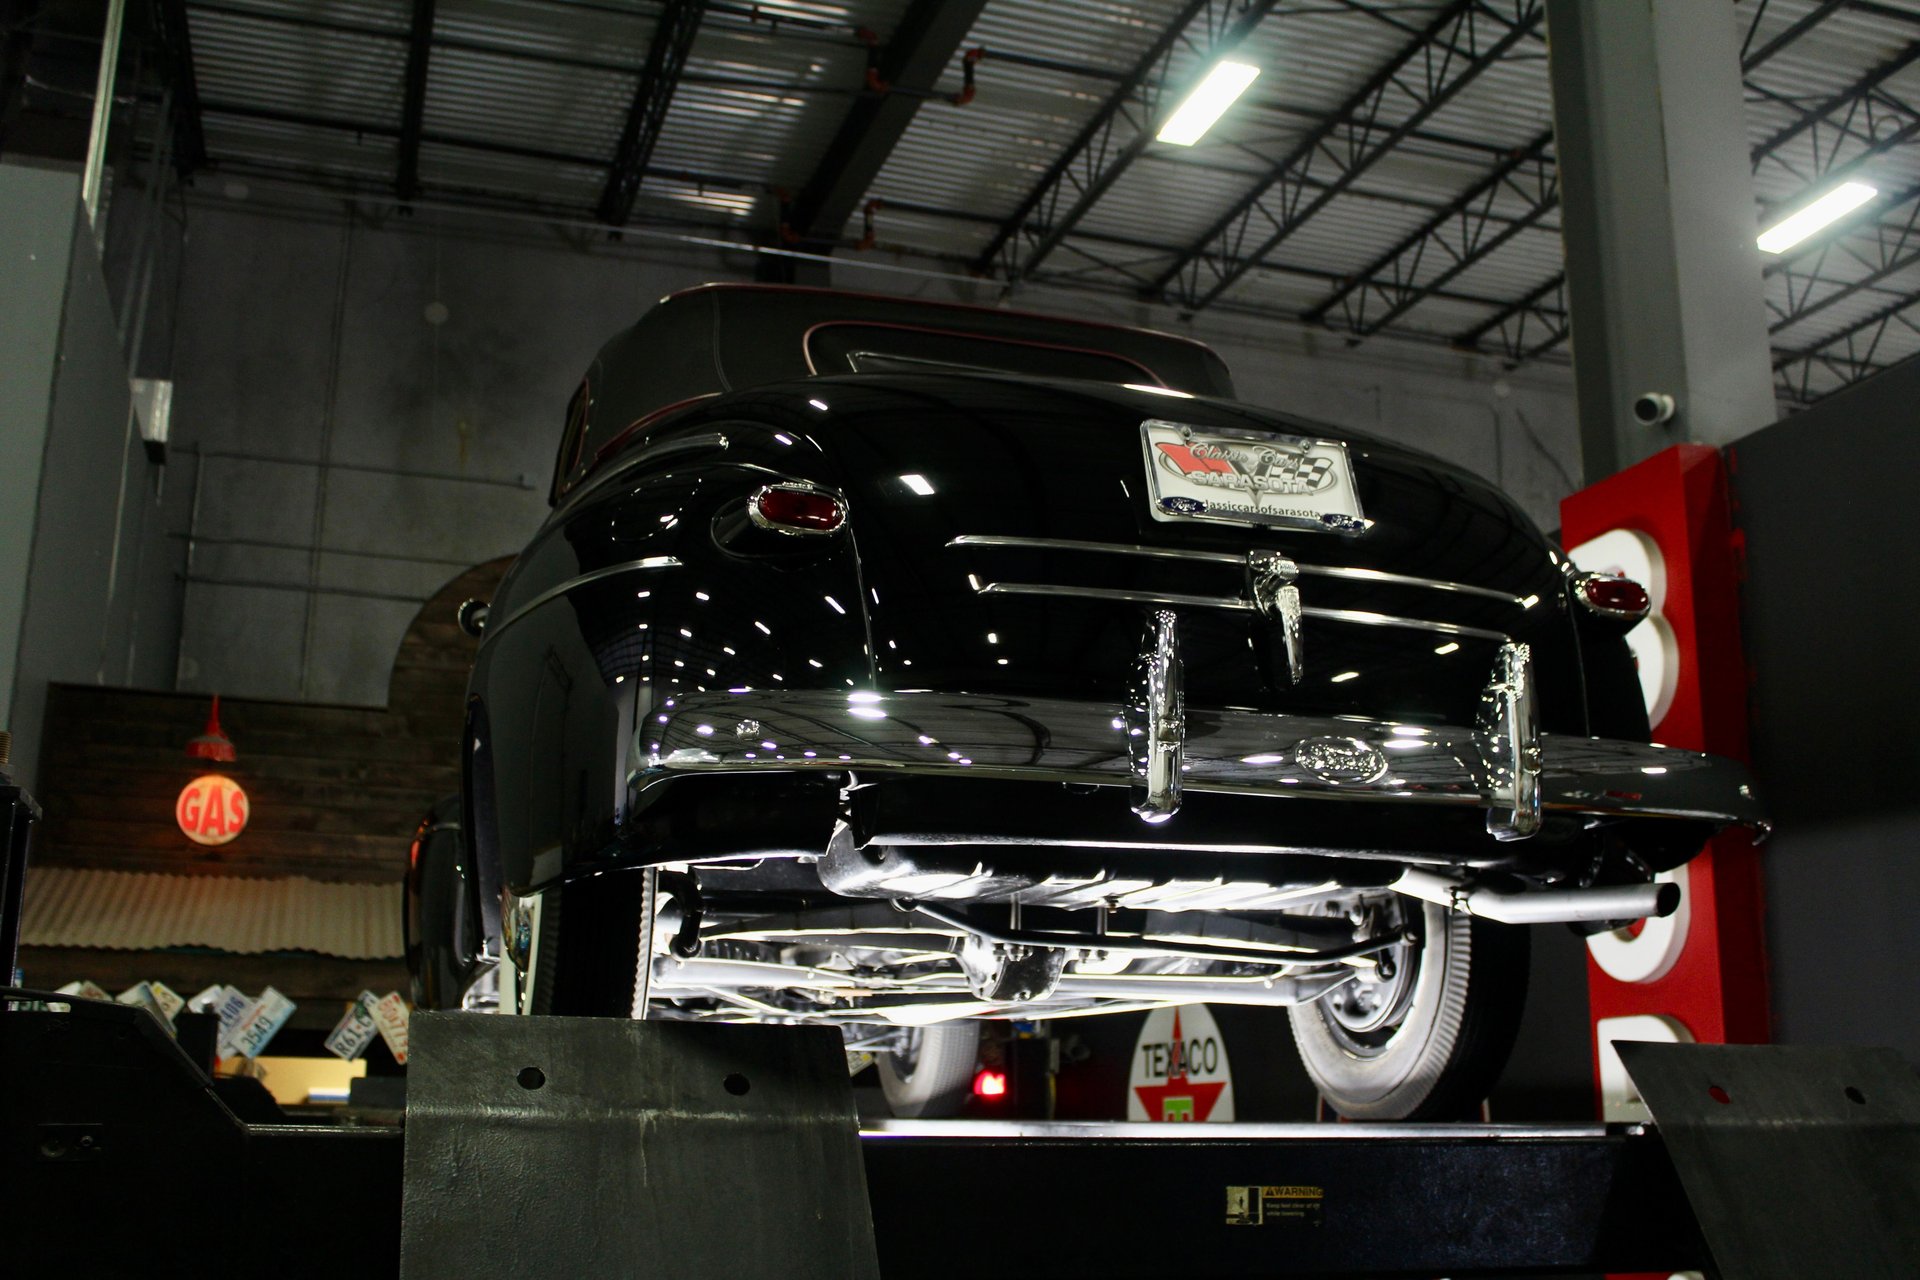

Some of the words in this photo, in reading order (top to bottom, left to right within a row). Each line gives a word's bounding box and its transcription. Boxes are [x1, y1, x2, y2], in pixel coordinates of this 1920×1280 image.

[1185, 441, 1249, 464] Classic
[1253, 446, 1299, 470] Cars
[1192, 470, 1315, 496] SARASOTA
[181, 786, 245, 836] GAS
[1142, 1037, 1218, 1078] TEXACO
[1274, 1187, 1324, 1197] WARNING
